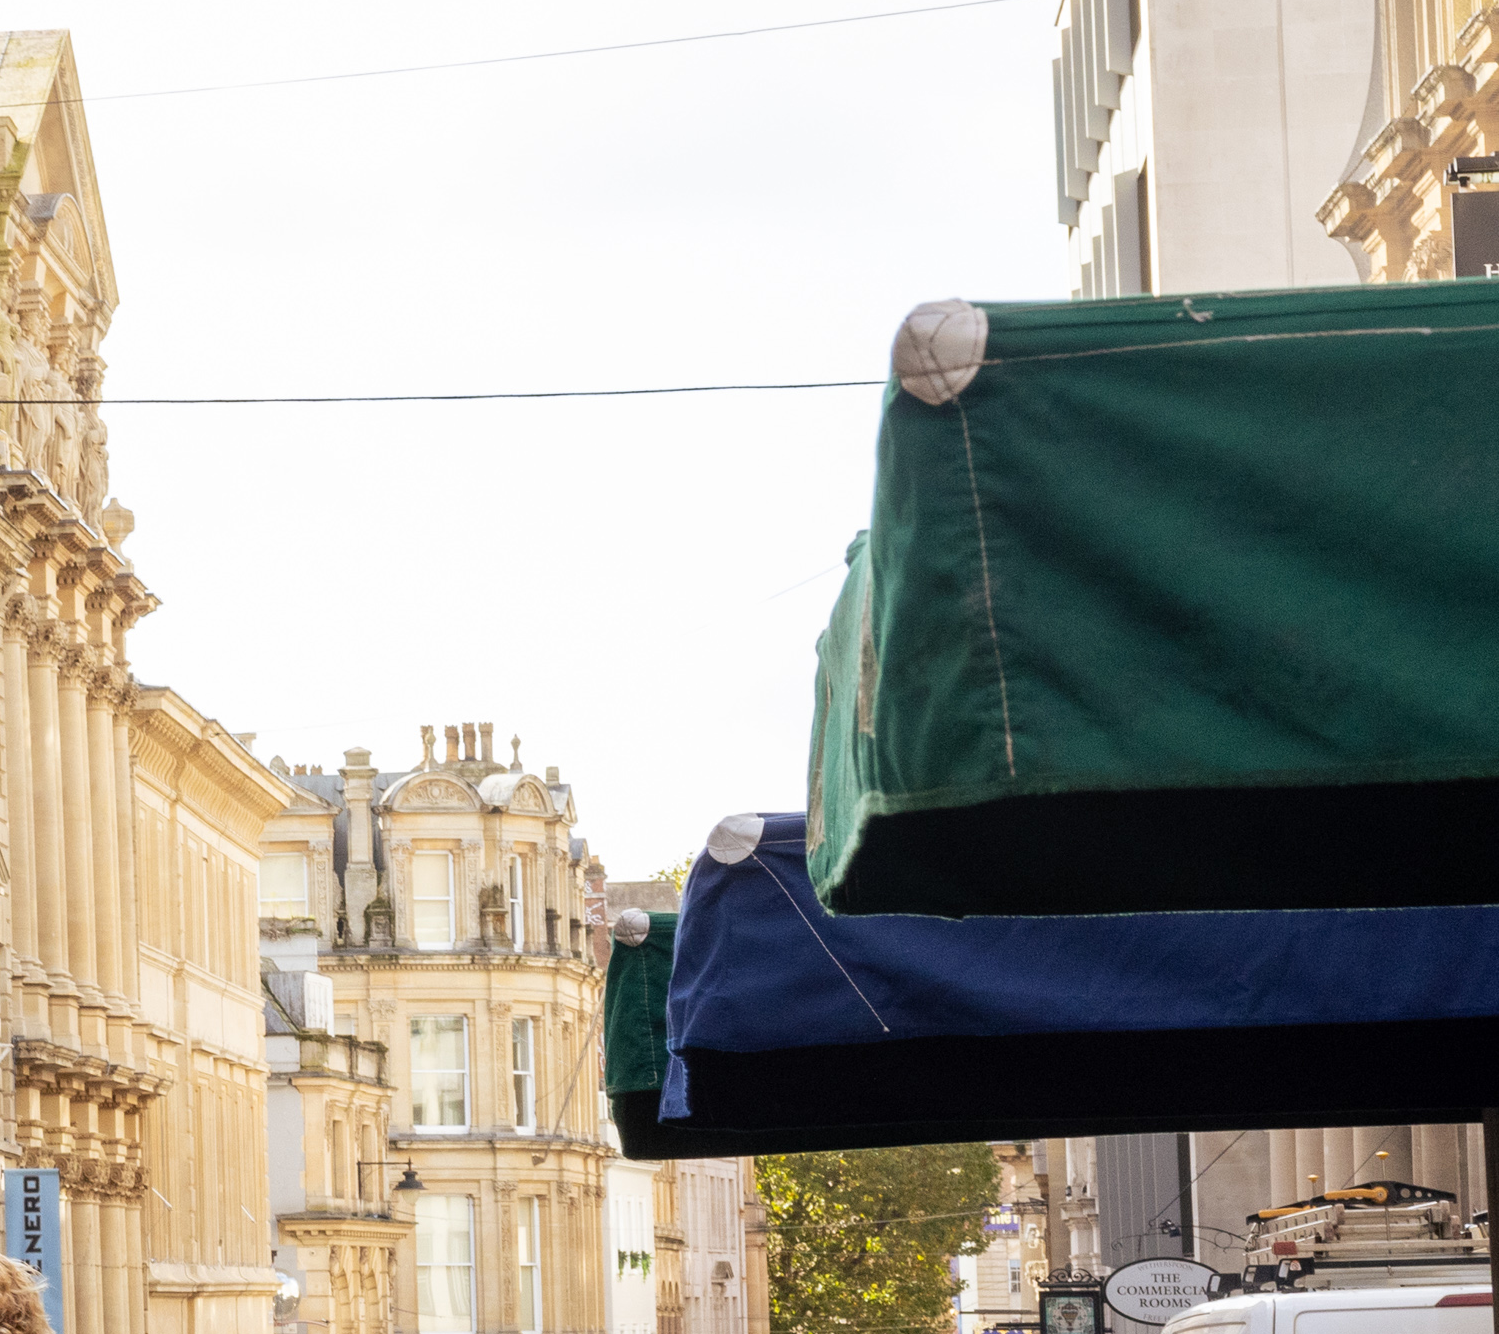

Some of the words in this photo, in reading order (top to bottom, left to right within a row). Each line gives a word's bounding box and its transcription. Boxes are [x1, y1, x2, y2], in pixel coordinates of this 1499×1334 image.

[23, 1175, 42, 1254] NERO
[1151, 1273, 1181, 1283] THE
[1116, 1286, 1208, 1296] COMMERCIA
[1140, 1298, 1192, 1308] ROOMS
